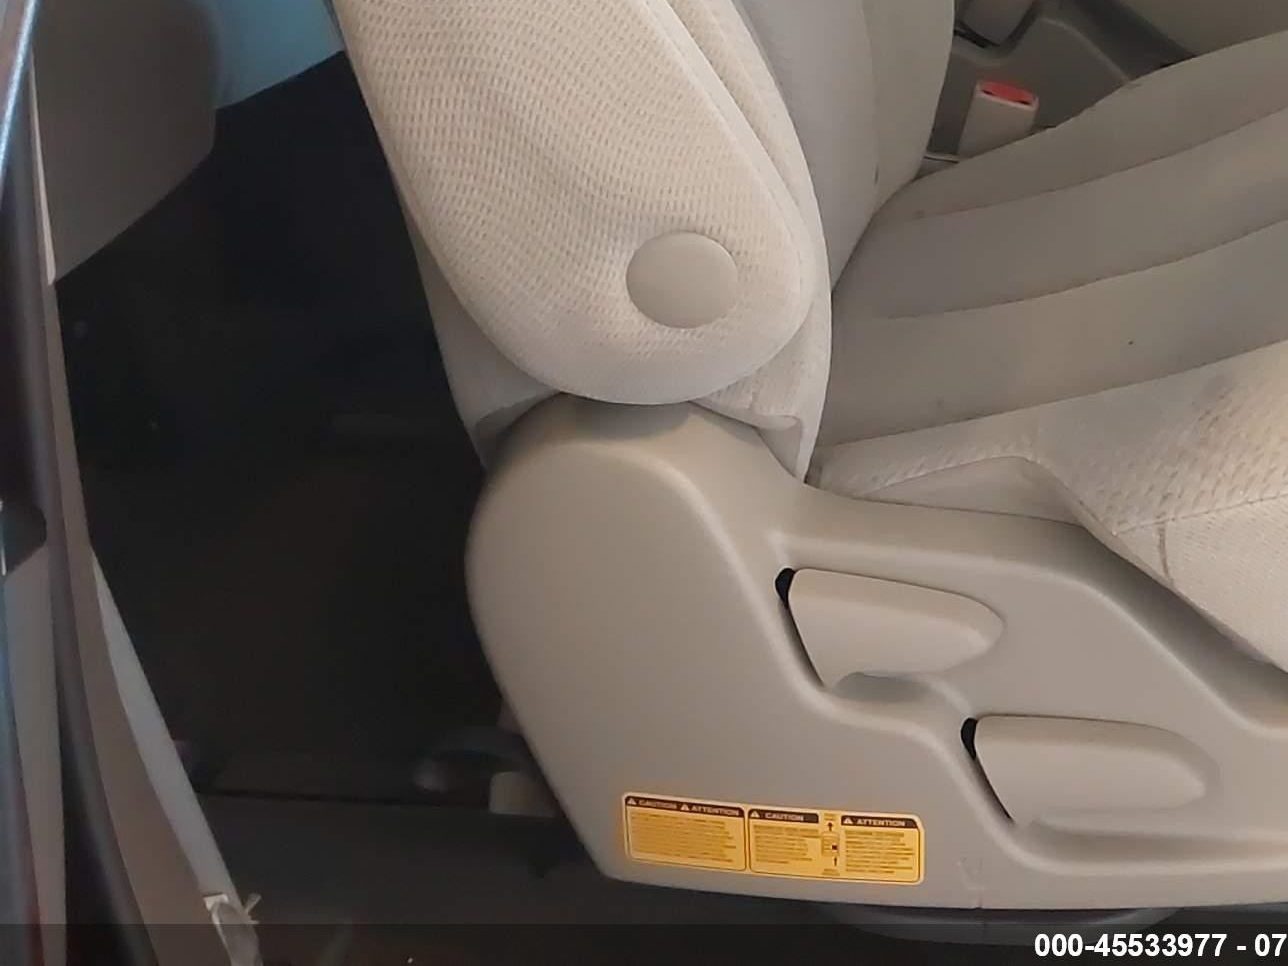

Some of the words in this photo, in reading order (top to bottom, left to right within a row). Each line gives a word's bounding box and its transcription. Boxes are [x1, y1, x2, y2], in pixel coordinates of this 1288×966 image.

[638, 799, 677, 809] CAUTION
[691, 804, 739, 816] ATTENTION
[765, 812, 804, 821] CAUTION
[856, 818, 906, 827] ATTENTION
